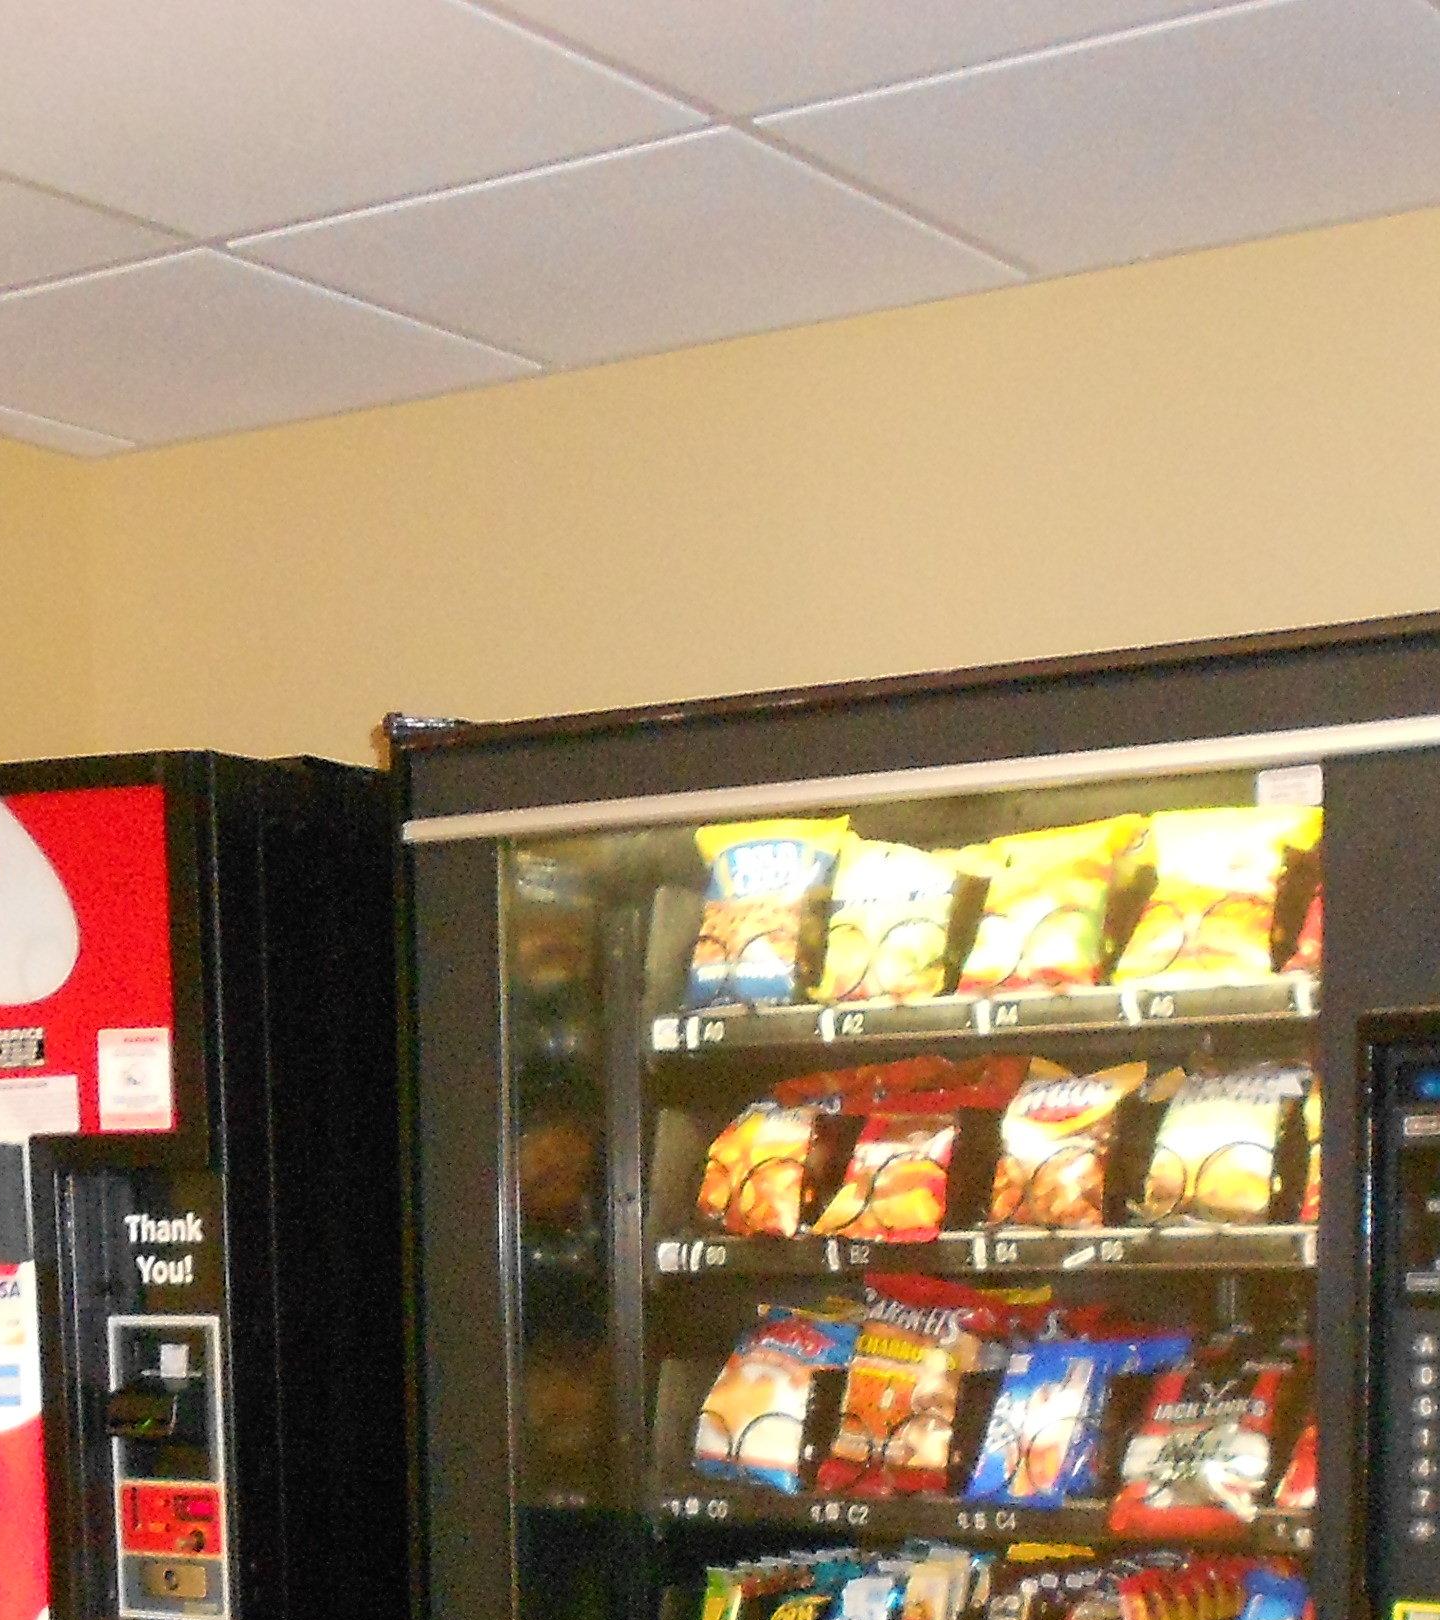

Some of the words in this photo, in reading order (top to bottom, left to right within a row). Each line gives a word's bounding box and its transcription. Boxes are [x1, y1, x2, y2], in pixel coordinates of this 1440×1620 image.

[124, 1212, 202, 1242] Thank
[135, 1254, 194, 1284] You!
[1154, 1401, 1200, 1420] JACK
[1419, 1489, 1430, 1507] 7
[847, 1503, 869, 1525] C2
